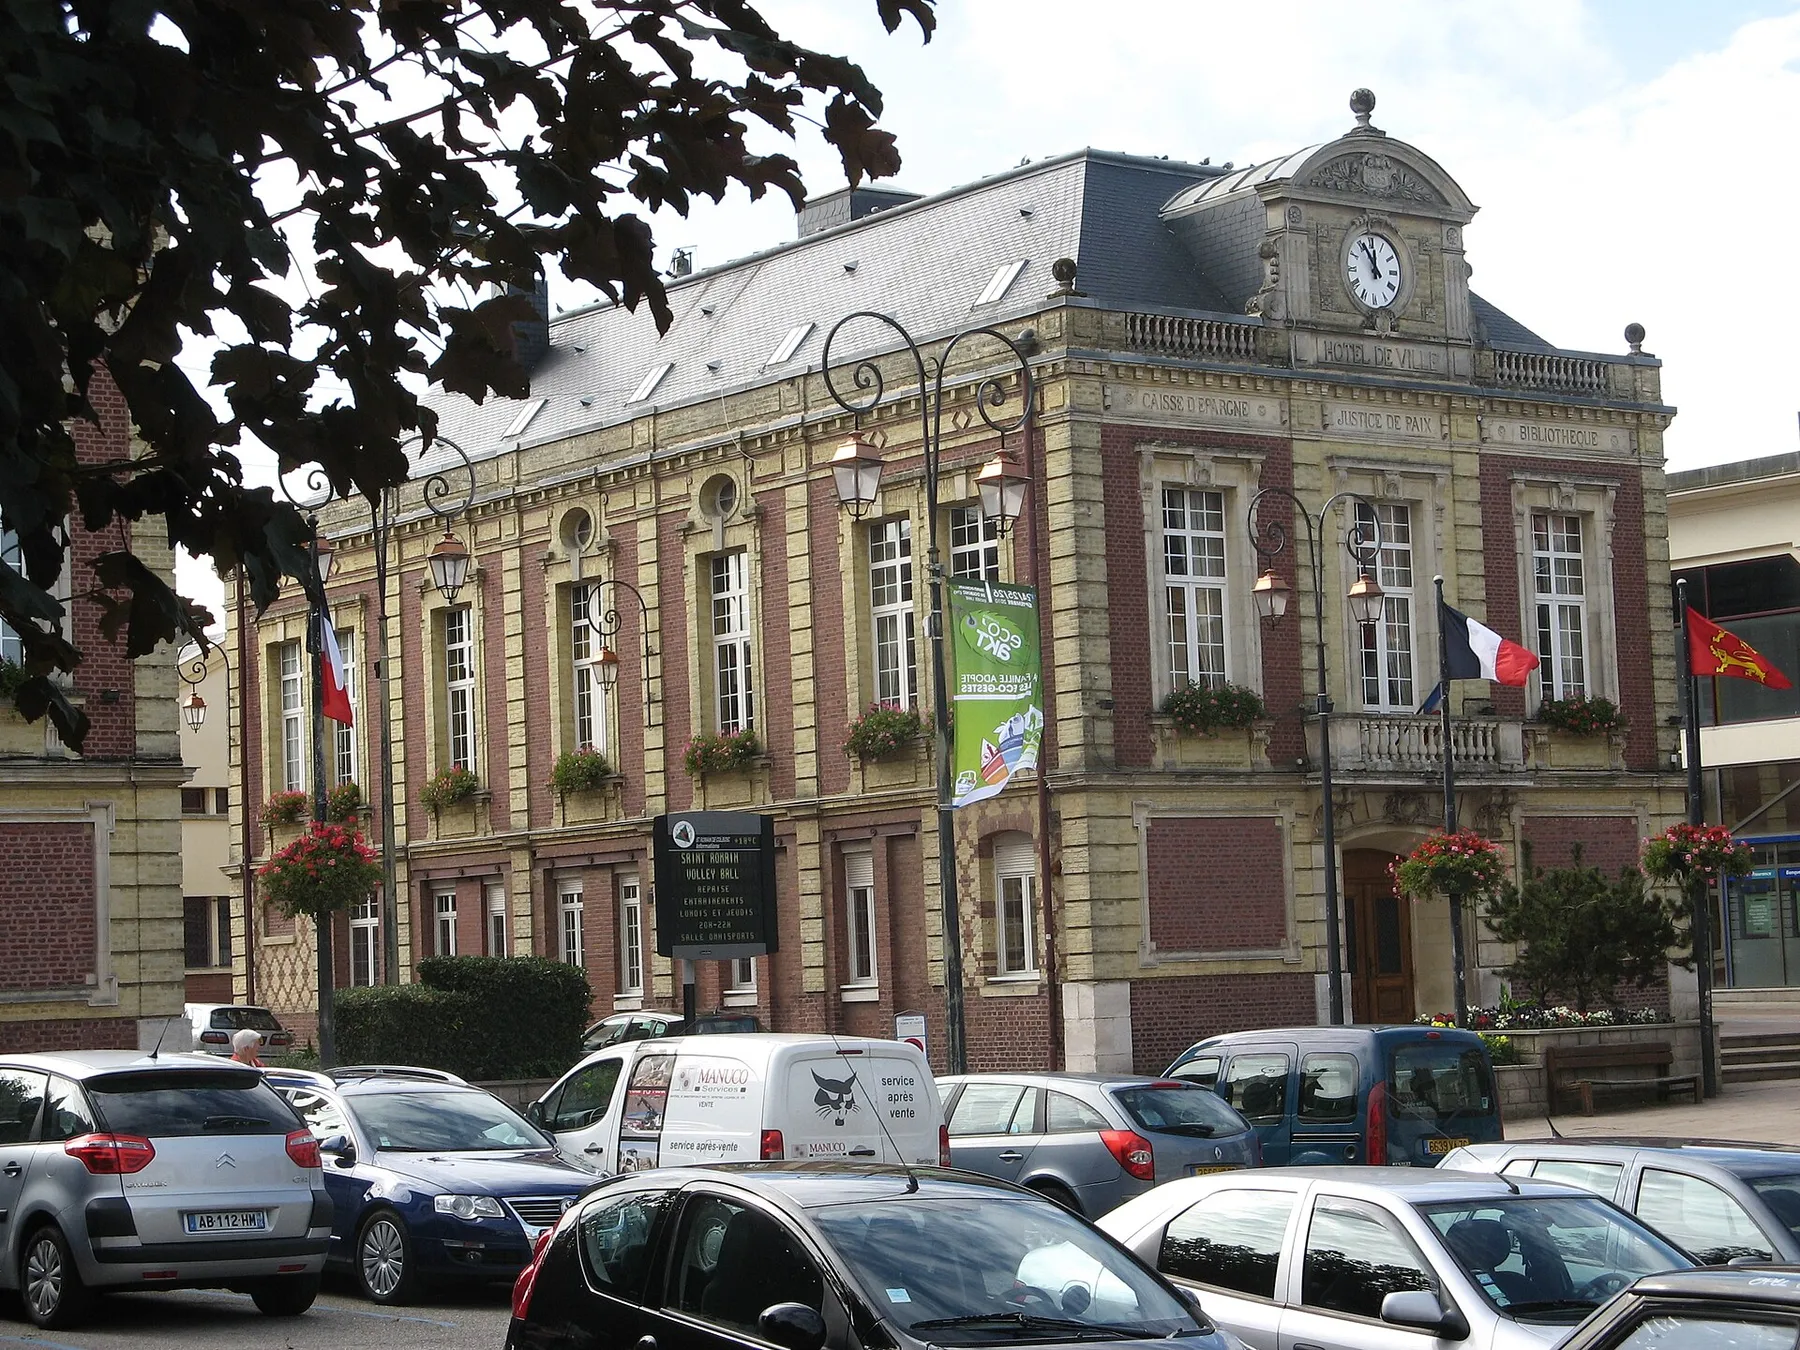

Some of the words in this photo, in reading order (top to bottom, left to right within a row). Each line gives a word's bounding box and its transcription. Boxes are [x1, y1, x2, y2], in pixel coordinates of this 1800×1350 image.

[1324, 340, 1371, 364] HOTEL
[1374, 345, 1393, 367] DE
[1395, 348, 1439, 371] VILLE
[1142, 392, 1184, 412] CAISSE
[1337, 410, 1382, 429] JUSTICE
[1386, 414, 1402, 431] DE
[1405, 416, 1433, 433] PAIX
[1520, 425, 1598, 447] BIBLIOTHEQUE
[681, 852, 705, 864] SAINT
[710, 852, 739, 864] ROMAIN
[686, 868, 716, 880] VOLLEY
[720, 868, 740, 880] BALL
[697, 885, 730, 893] REPRISE
[684, 896, 744, 906] ENTRAINEMENTS
[680, 909, 708, 918] LUNDIS
[712, 909, 721, 917] ET
[726, 908, 754, 917] JEUDIS
[681, 933, 704, 942] SALLE
[709, 931, 755, 941] OMNISPORTS
[698, 1068, 749, 1084] MANUCO
[881, 1075, 915, 1086] service
[701, 1085, 739, 1093] Services
[887, 1091, 914, 1105] après
[889, 1107, 915, 1118] vente
[669, 1140, 695, 1150] service
[809, 1142, 846, 1153] MANUCO
